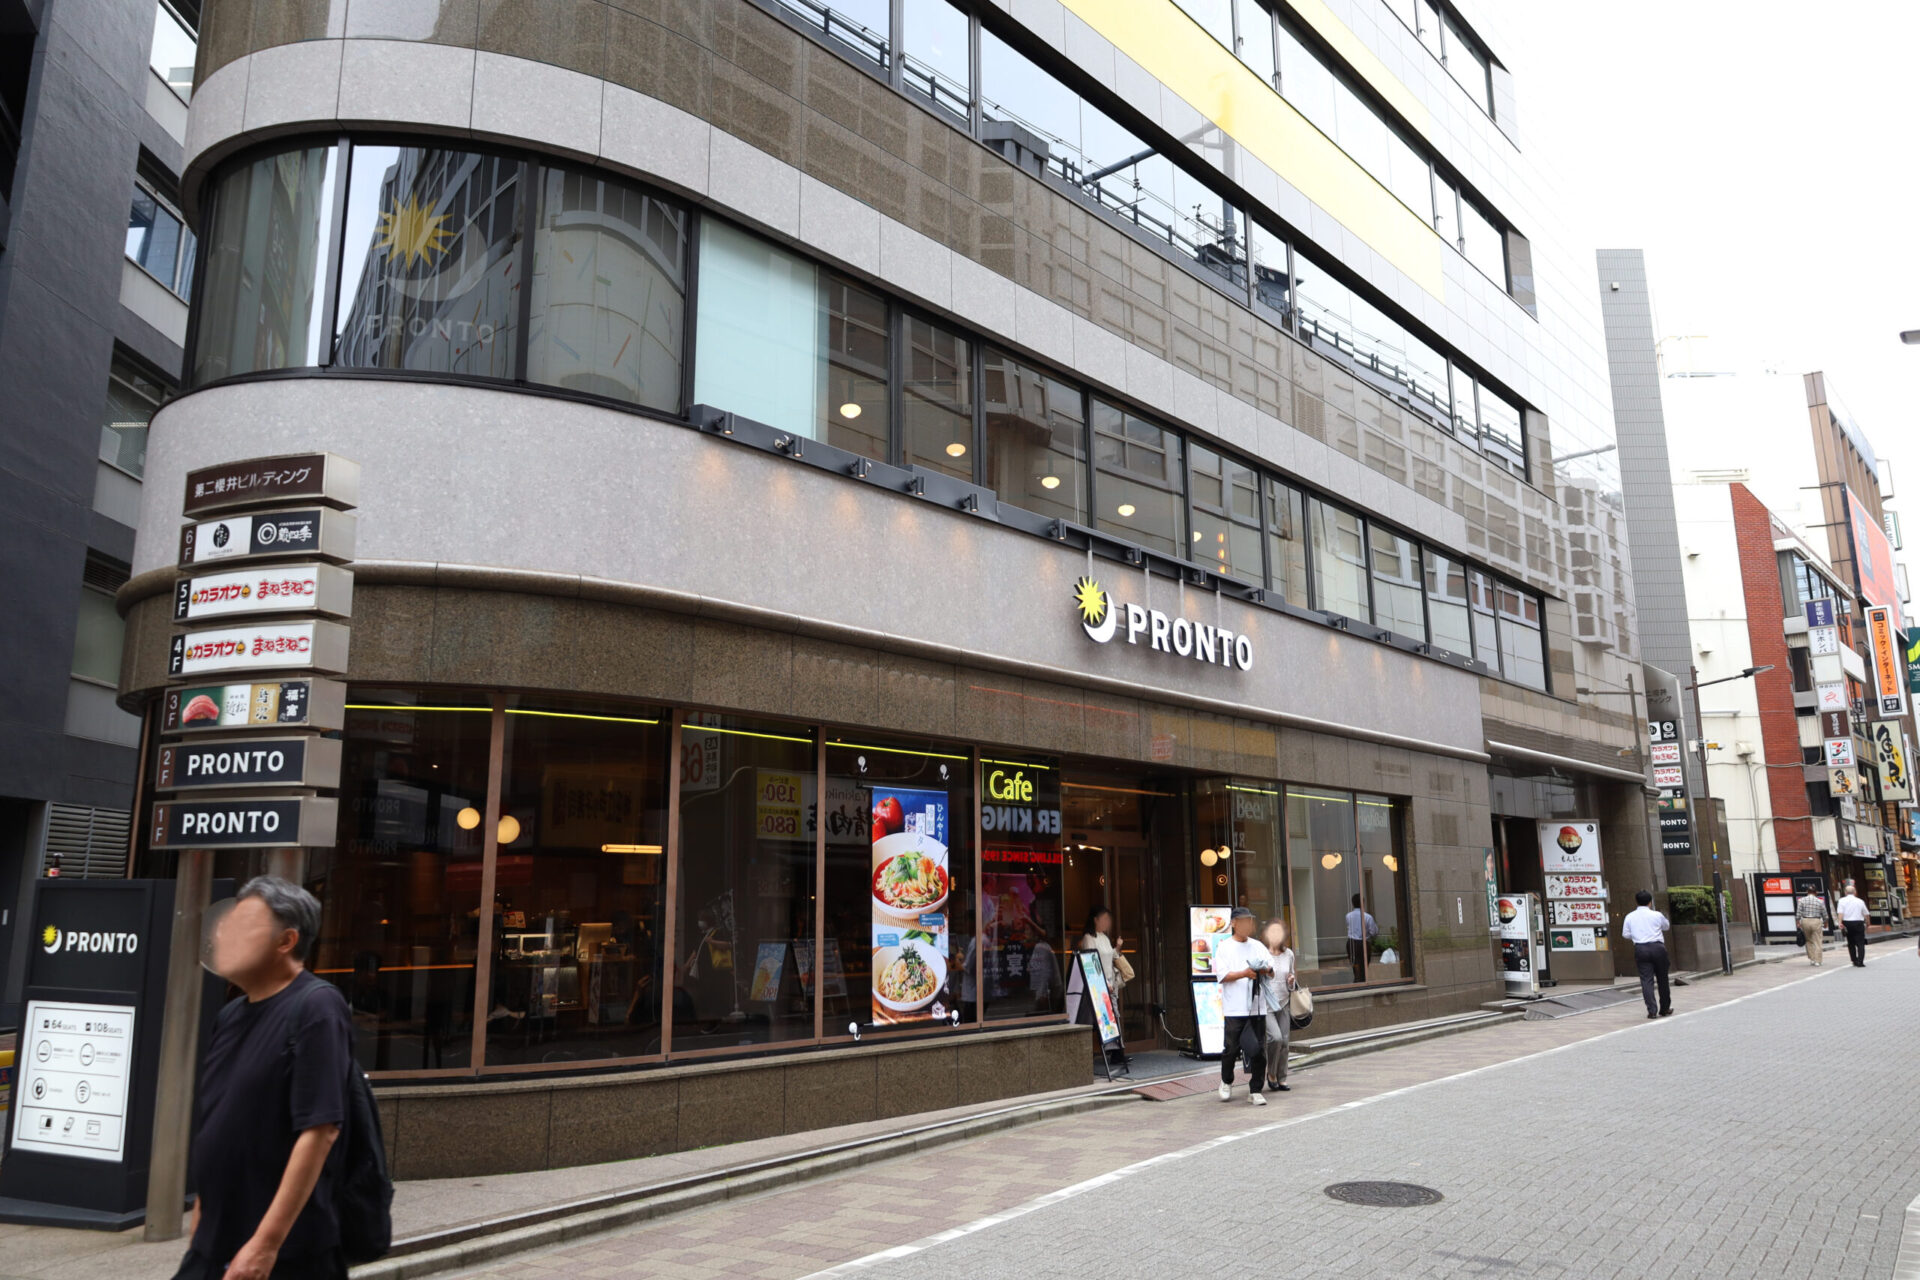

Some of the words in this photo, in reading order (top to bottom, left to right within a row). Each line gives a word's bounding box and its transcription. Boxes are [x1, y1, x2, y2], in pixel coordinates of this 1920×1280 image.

[365, 314, 495, 344] PRONTO
[198, 587, 243, 603] カラオケ
[257, 579, 315, 600] まねきねこ
[193, 641, 238, 659] カラオケ
[252, 636, 310, 656] まねきねこ
[1124, 603, 1253, 671] PRONTO
[187, 751, 285, 776] PRONTO
[1877, 724, 1907, 789] 魚民
[990, 770, 1033, 801] Cafe
[1236, 796, 1264, 820] Beer
[182, 811, 280, 835] PRONTO
[1561, 855, 1582, 863] もんじゃ
[1565, 885, 1598, 896] まねきねこ
[1572, 911, 1602, 922] まねきねこ
[65, 931, 138, 954] PRONTO
[51, 1019, 62, 1029] 64
[93, 1022, 108, 1032] 108
